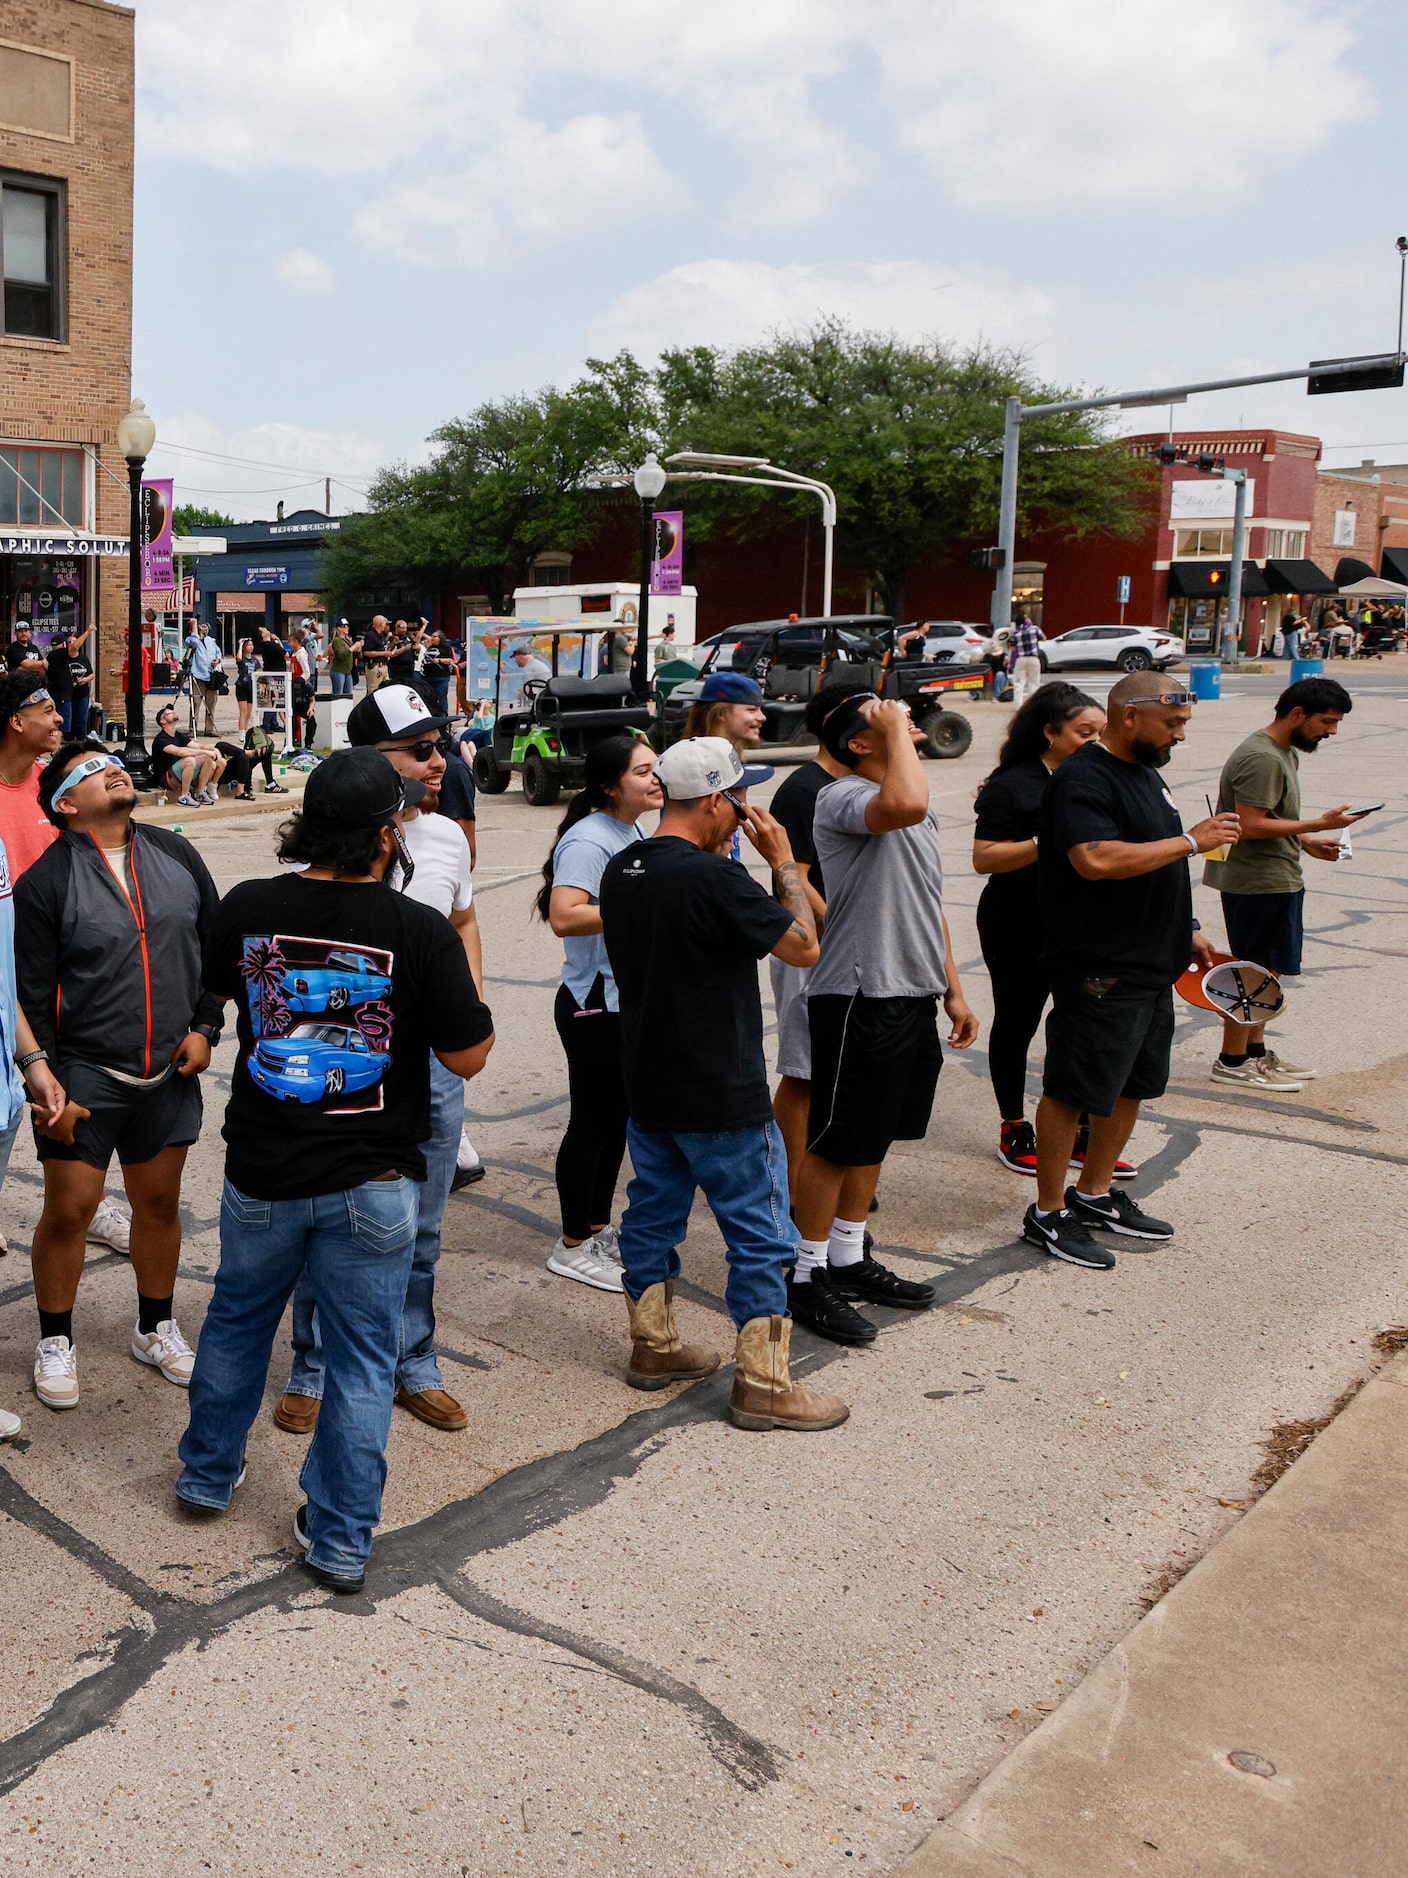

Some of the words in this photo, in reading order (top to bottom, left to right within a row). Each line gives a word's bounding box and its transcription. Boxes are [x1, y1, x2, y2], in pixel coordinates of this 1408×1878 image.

[307, 522, 333, 531] GRIMES
[66, 541, 126, 556] SOLUT
[1121, 576, 1131, 596] H
